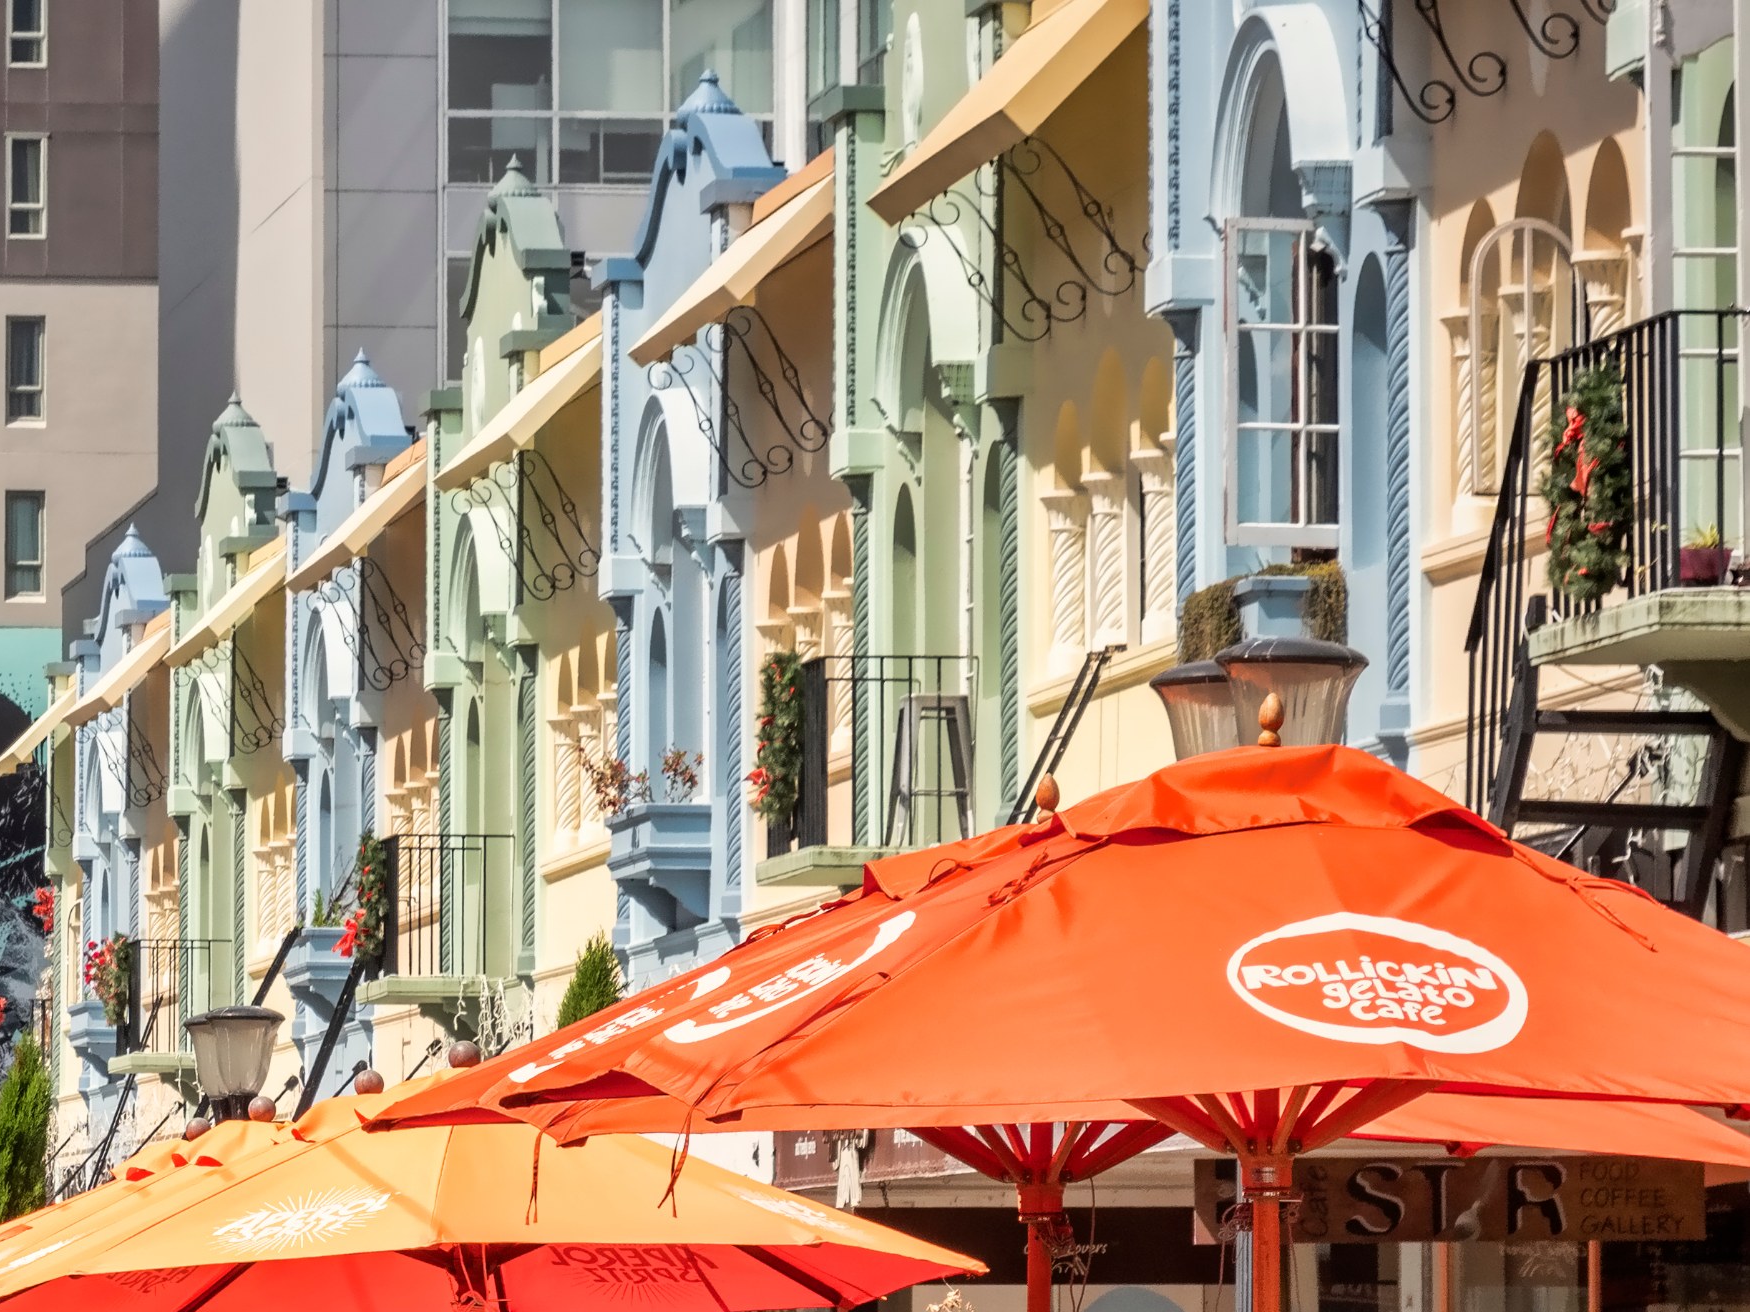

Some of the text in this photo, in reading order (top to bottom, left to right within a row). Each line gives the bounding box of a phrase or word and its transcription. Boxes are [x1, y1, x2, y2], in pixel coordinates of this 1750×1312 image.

[1579, 1163, 1641, 1182] FOOD
[1579, 1188, 1668, 1207] COFFEE
[212, 1193, 391, 1236] APEROL
[1579, 1213, 1684, 1236] GALLERY
